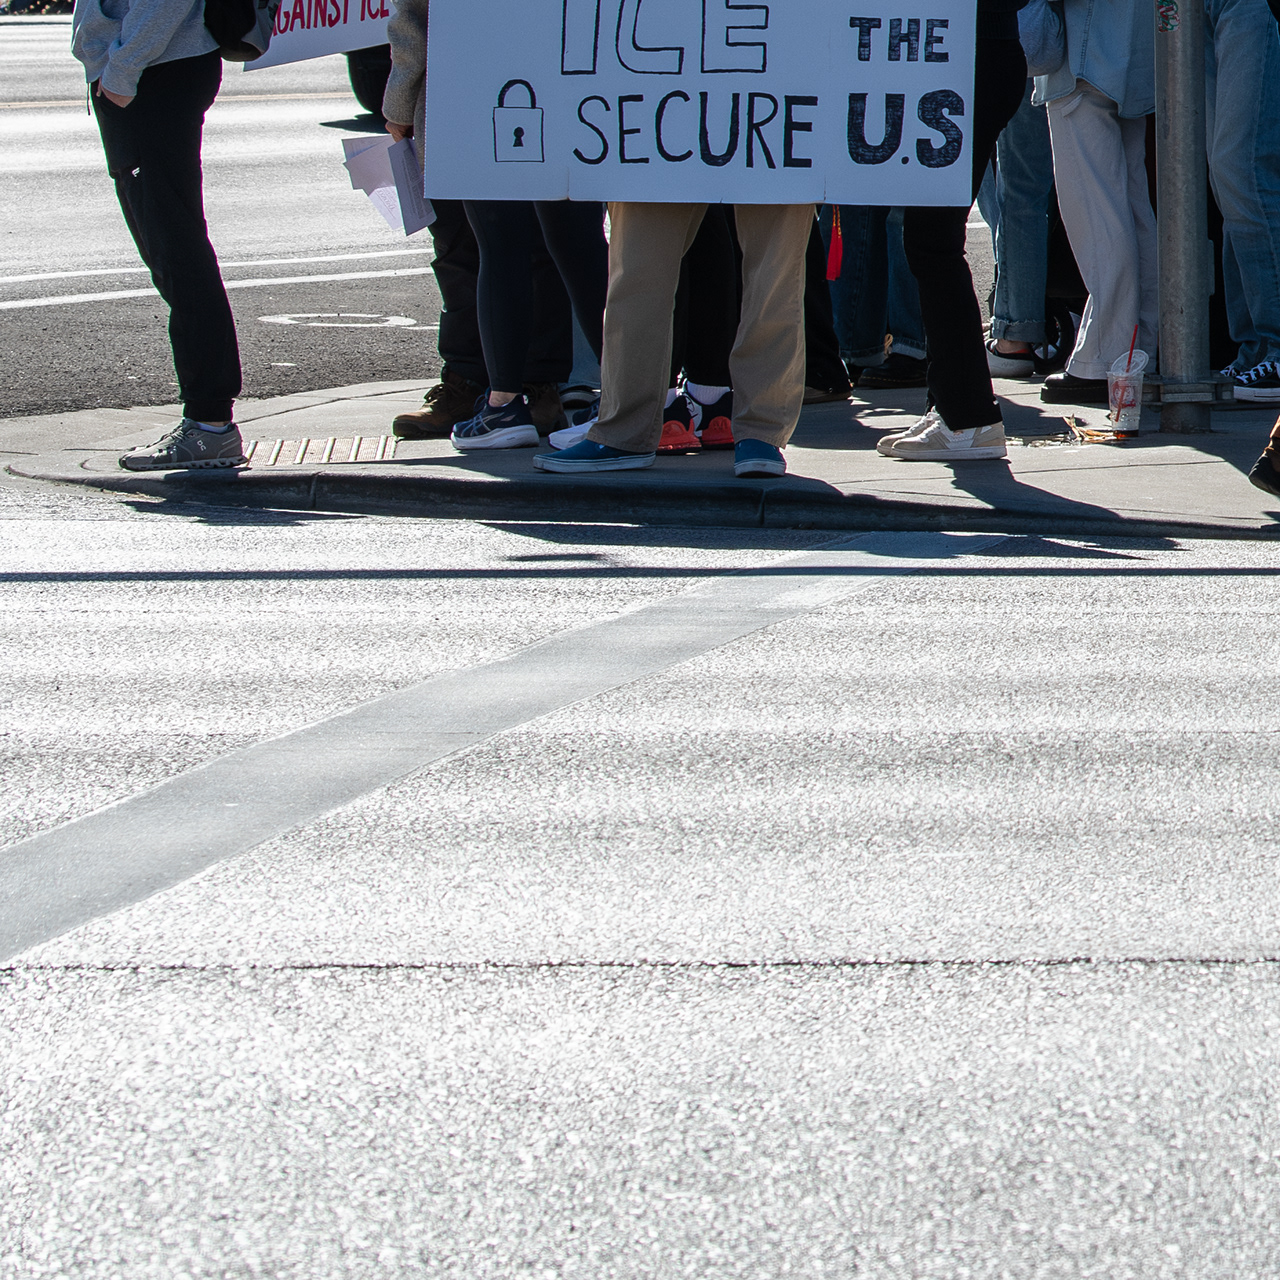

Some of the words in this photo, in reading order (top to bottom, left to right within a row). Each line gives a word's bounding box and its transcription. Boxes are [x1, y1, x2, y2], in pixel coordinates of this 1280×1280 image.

[849, 17, 949, 62] THE
[573, 90, 818, 168] SECURE
[847, 89, 965, 168] U.S
